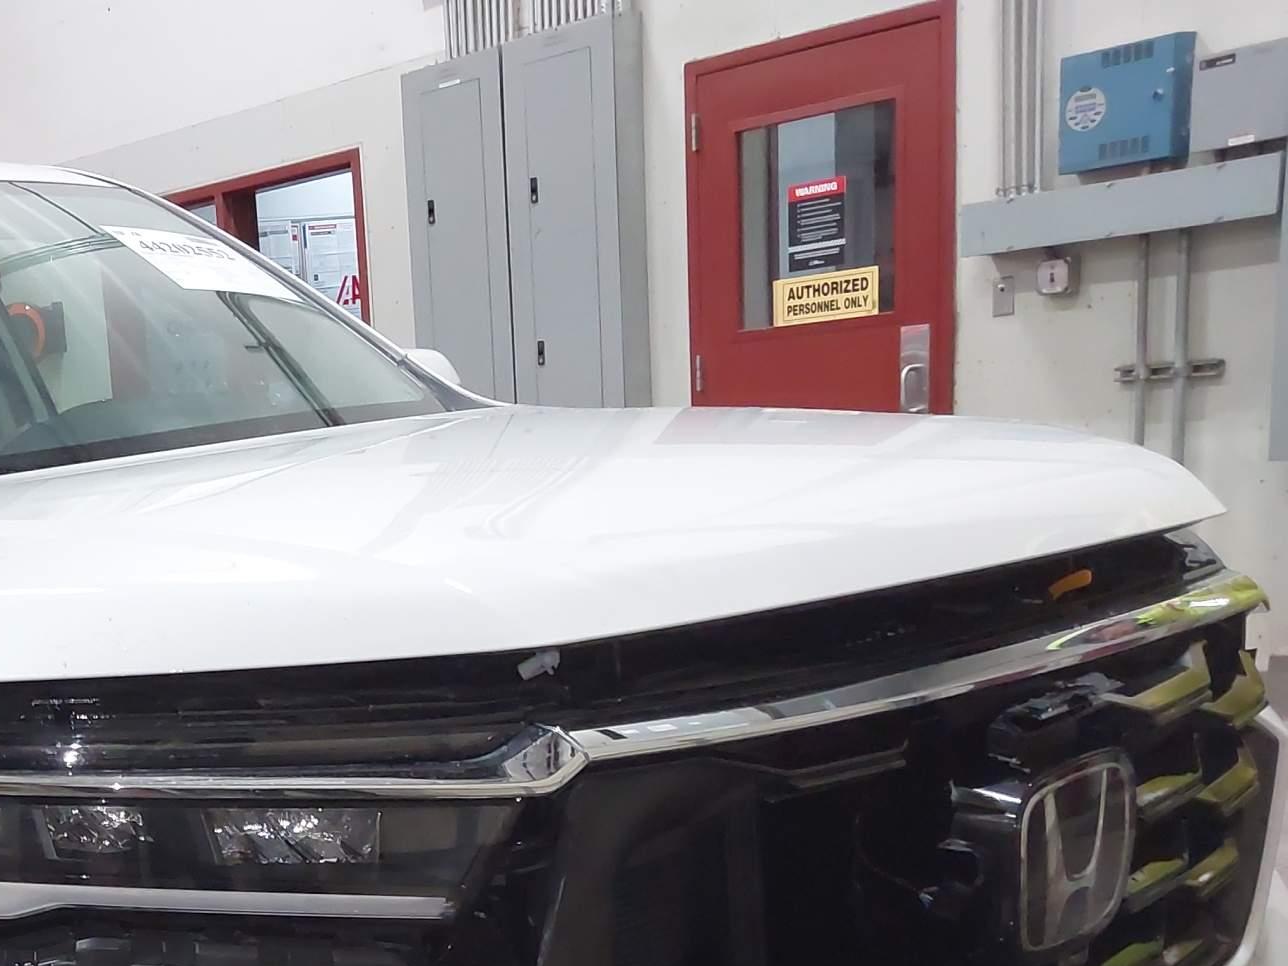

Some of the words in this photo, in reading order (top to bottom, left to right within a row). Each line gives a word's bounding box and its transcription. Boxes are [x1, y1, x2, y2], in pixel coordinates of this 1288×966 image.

[795, 181, 838, 197] WARNING
[787, 276, 869, 301] AUTHORIZED
[786, 299, 841, 317] PERSONNEL
[844, 294, 869, 310] ONLY
